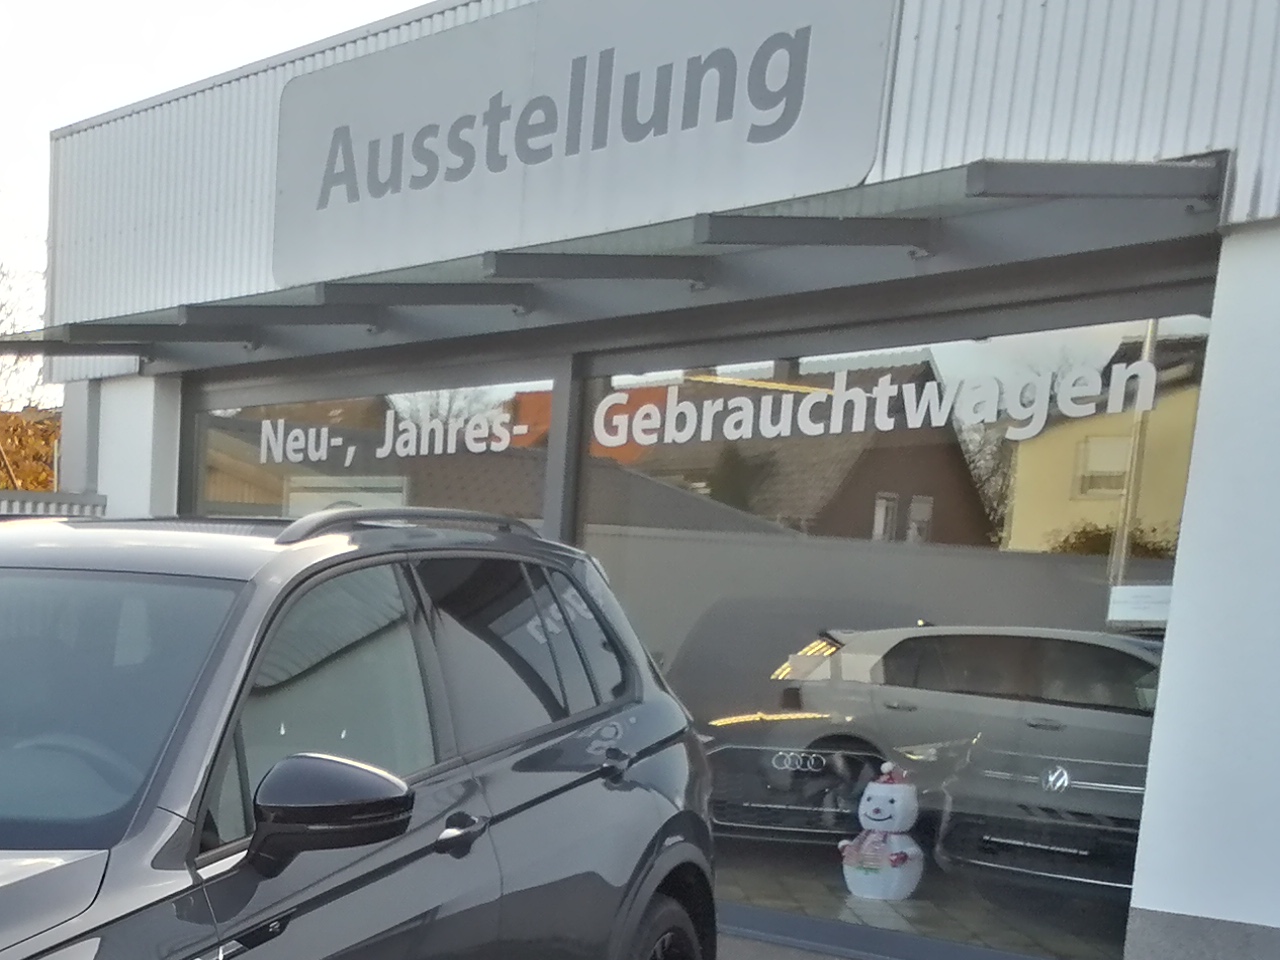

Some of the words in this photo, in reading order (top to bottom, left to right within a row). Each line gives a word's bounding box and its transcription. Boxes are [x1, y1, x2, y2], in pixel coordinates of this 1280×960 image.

[316, 25, 812, 210] Ausstellung
[259, 418, 357, 467] Neu-,
[376, 409, 529, 458] Jahres-
[593, 359, 1157, 447] Gebrauchtwagen
